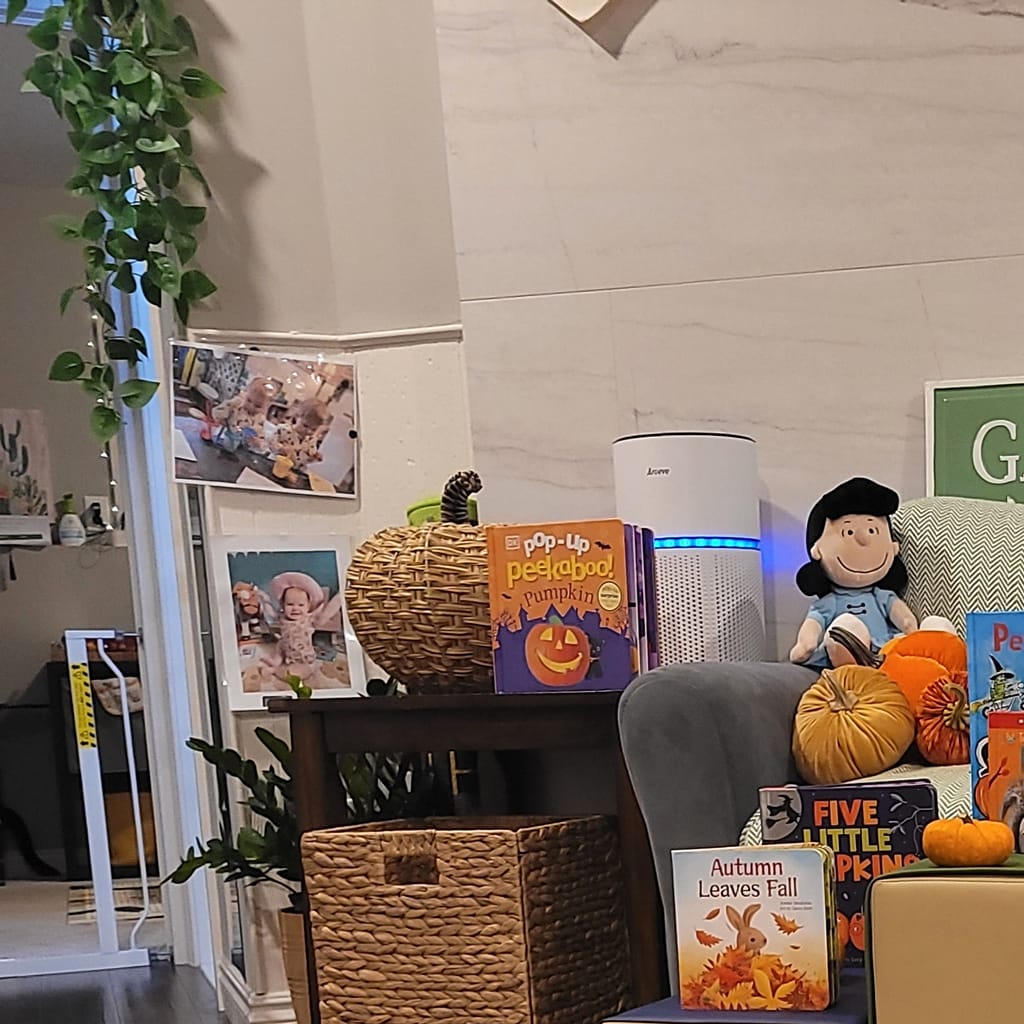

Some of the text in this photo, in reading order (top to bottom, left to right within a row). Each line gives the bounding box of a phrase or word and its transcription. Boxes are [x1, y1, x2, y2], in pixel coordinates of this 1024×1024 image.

[523, 531, 591, 558] pop-up
[506, 554, 615, 589] peekaboo!
[523, 583, 594, 607] Pumpkin
[813, 799, 879, 827] FIVE
[802, 827, 893, 852] LITTLE
[710, 858, 784, 877] Autumn
[834, 853, 921, 882] PKIN
[698, 877, 798, 898] Leaves Fall
